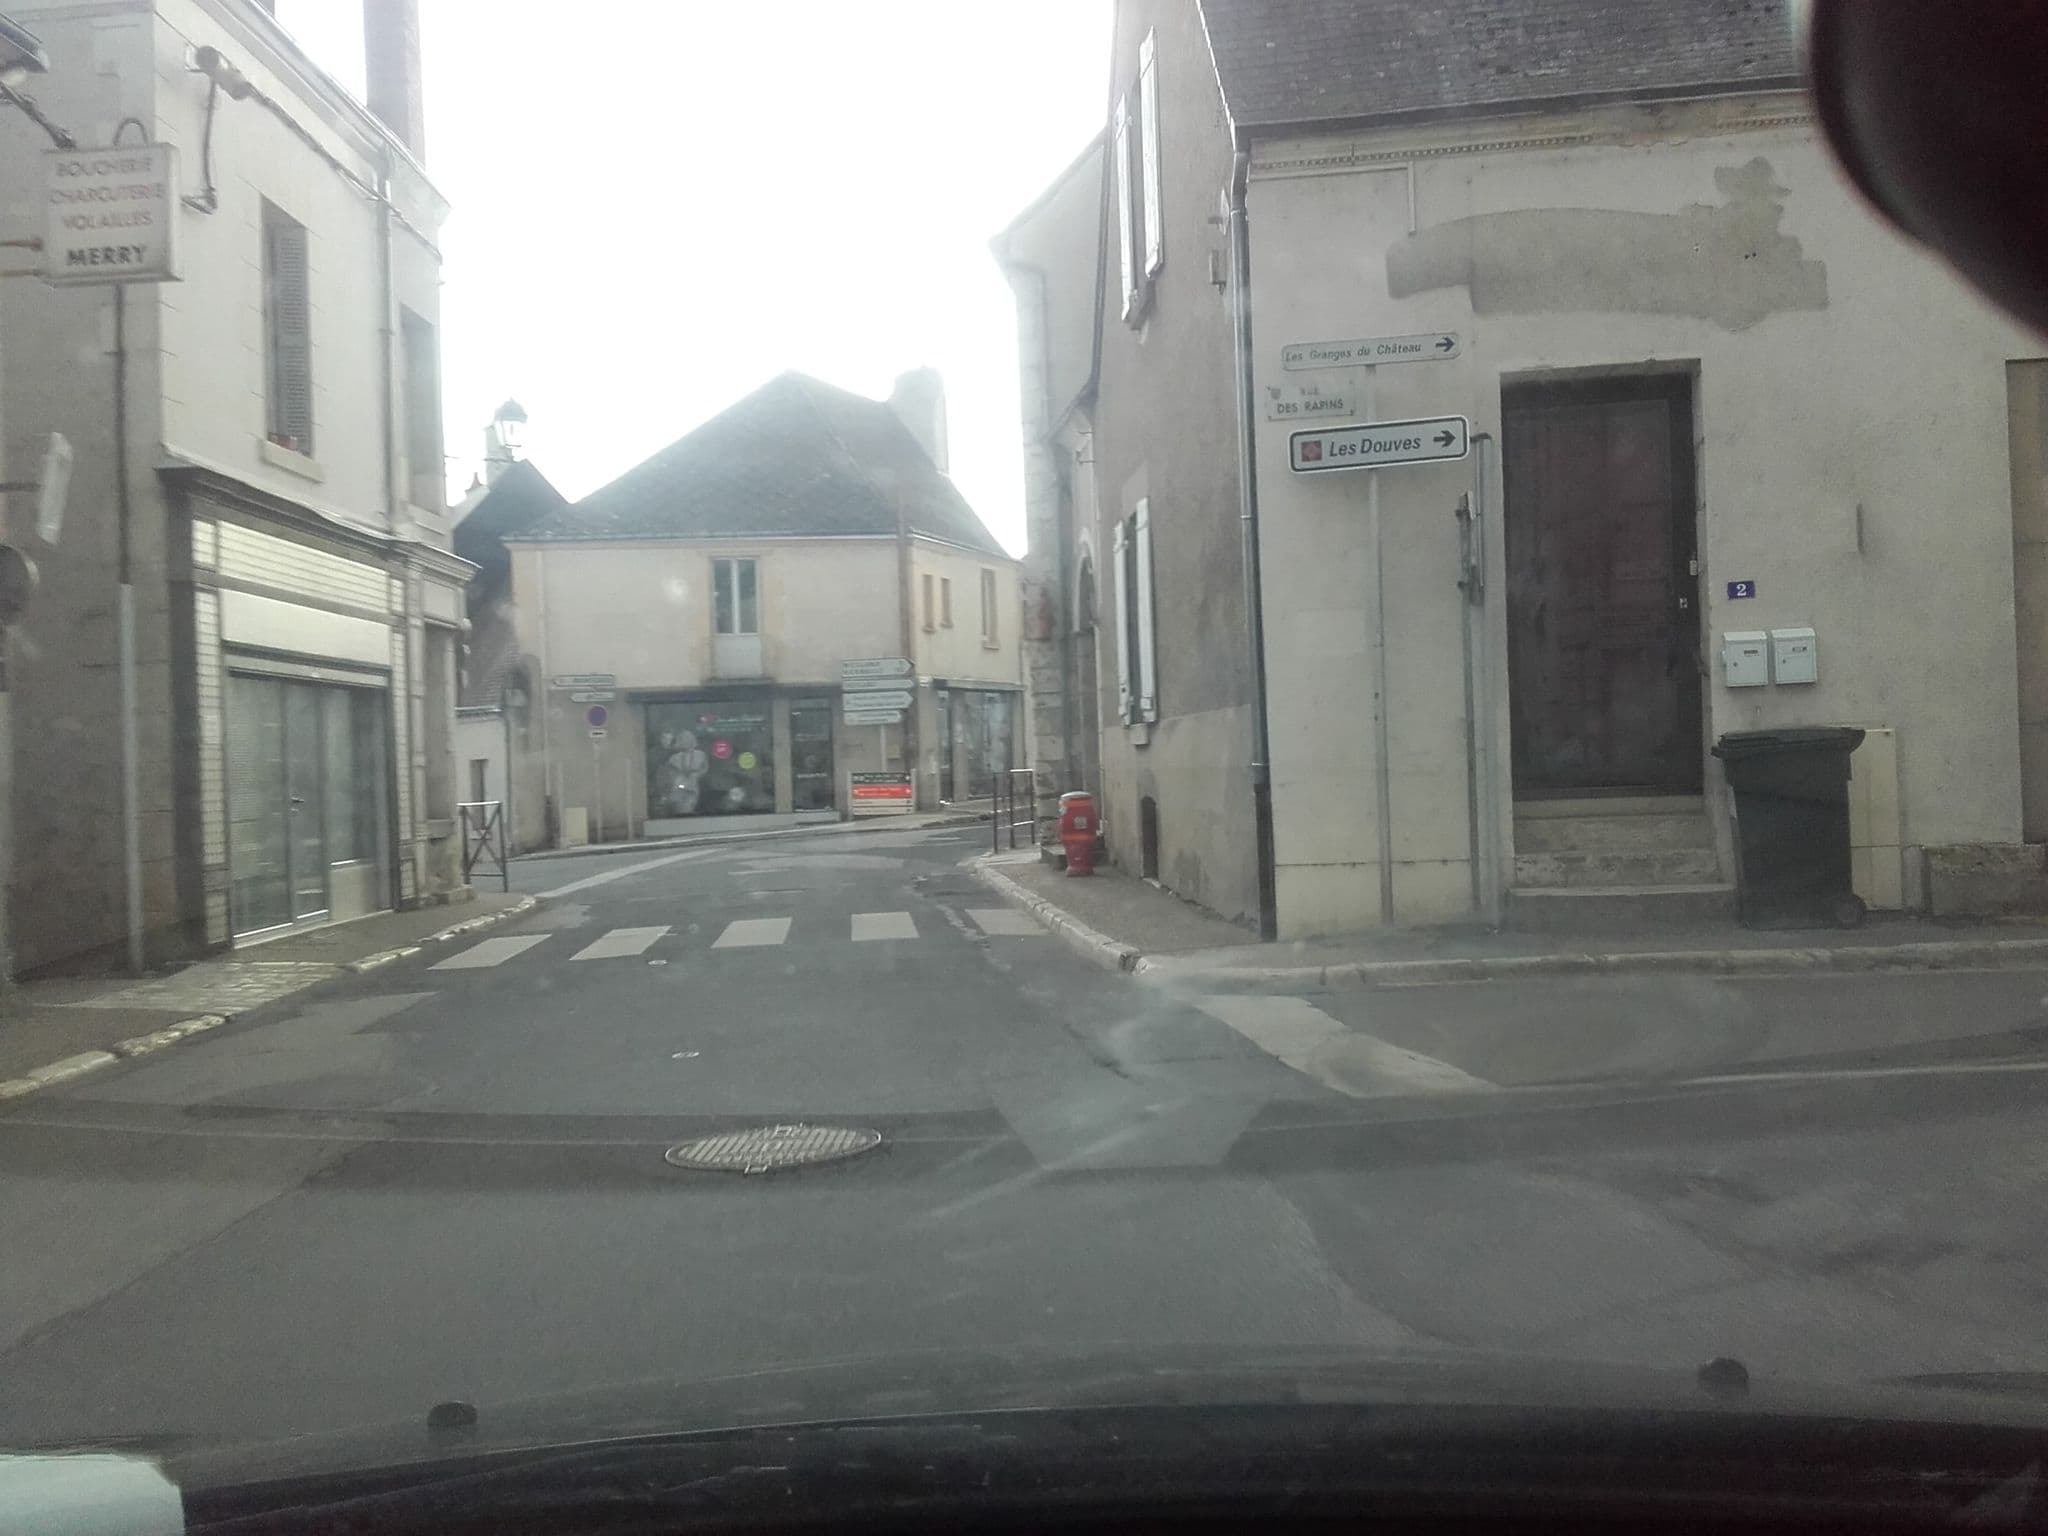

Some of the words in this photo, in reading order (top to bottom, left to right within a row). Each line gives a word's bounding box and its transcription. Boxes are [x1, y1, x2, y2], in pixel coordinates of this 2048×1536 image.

[66, 244, 147, 266] MERRY
[1285, 352, 1303, 362] Les
[1309, 349, 1351, 362] Granges
[1357, 345, 1370, 357] du
[1376, 342, 1421, 355] Château
[1277, 401, 1298, 414] DES
[1305, 399, 1344, 412] RAPINS
[1329, 441, 1356, 458] Les
[1361, 437, 1421, 455] Douves
[1736, 583, 1747, 597] 2
